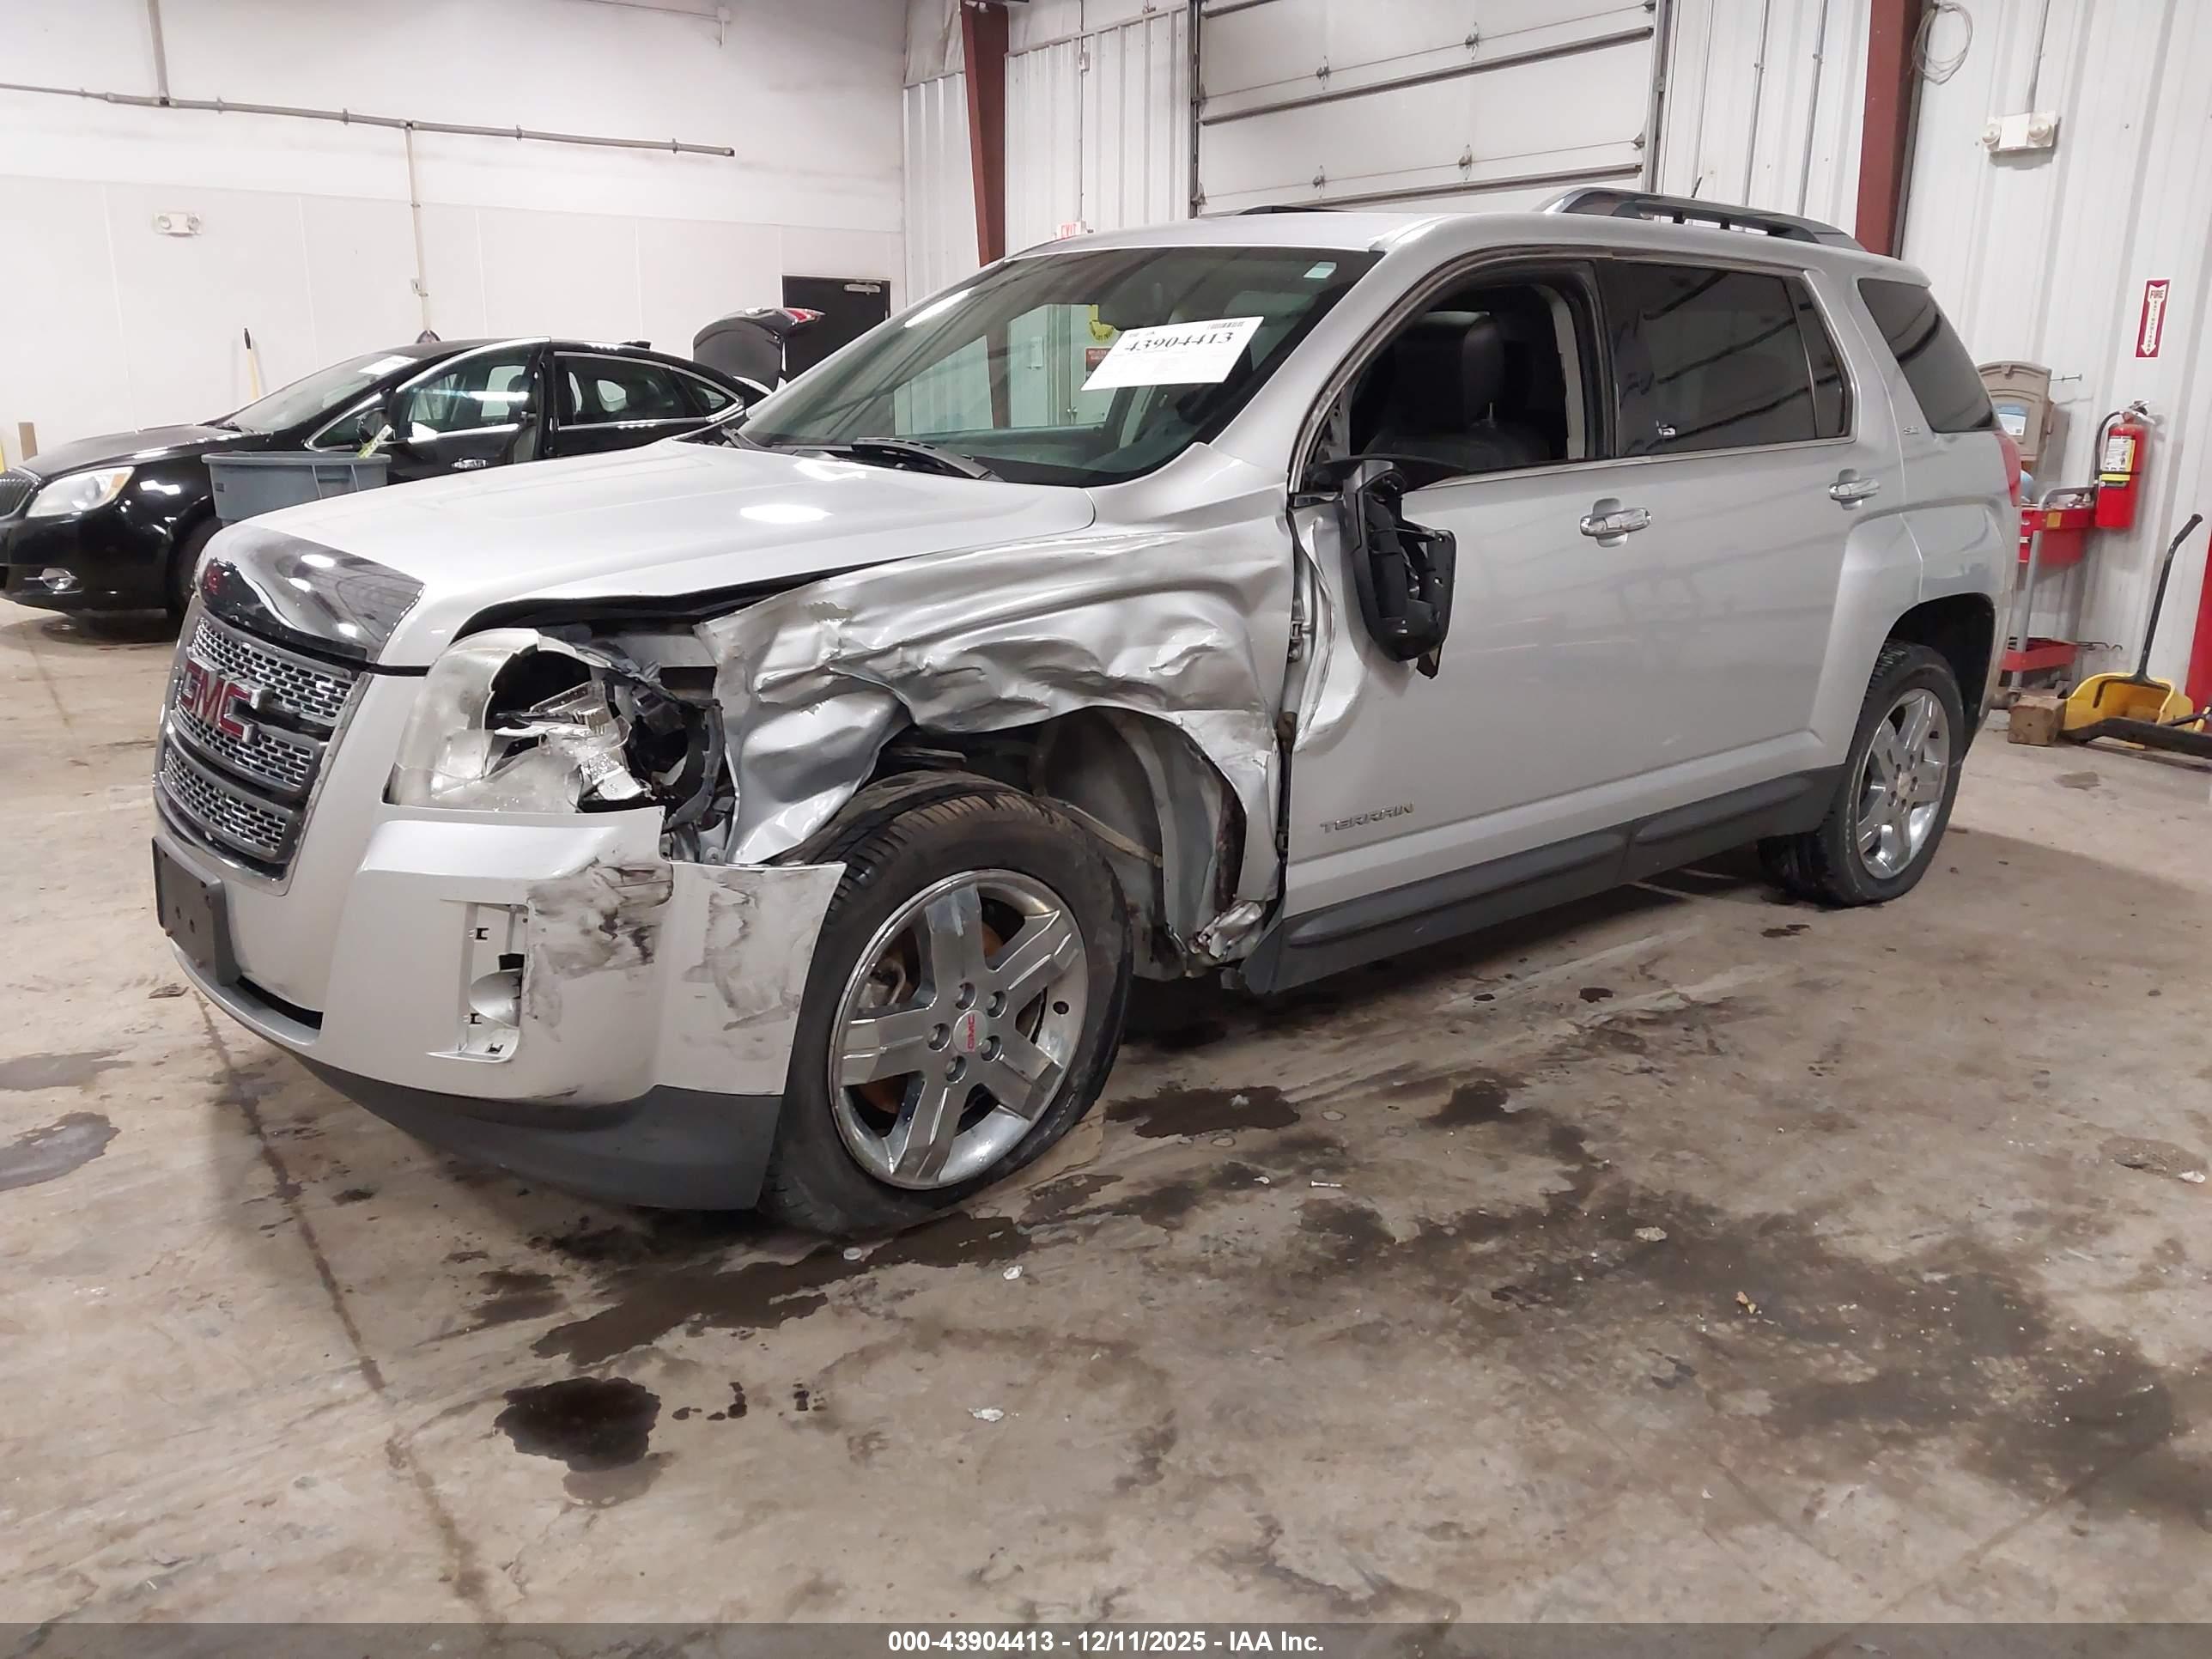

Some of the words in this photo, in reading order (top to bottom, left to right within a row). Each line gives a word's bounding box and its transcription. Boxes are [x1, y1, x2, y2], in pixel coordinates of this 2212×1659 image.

[2149, 289, 2164, 299] FIRE
[1125, 331, 1234, 351] 43904413
[179, 656, 271, 743] GMC
[1319, 802, 1414, 834] TERRAIN
